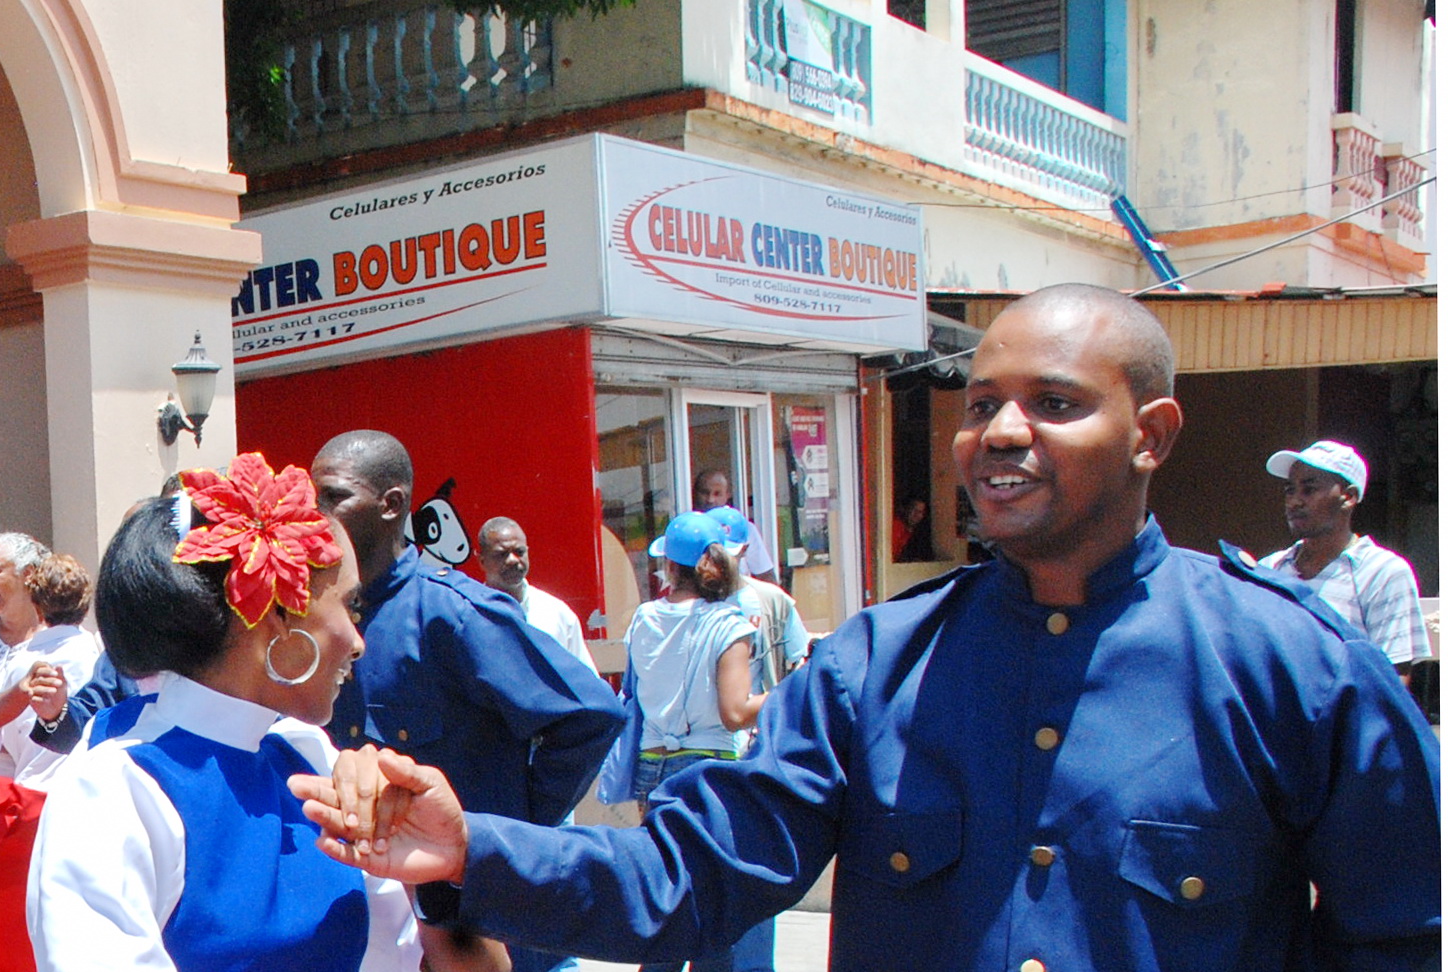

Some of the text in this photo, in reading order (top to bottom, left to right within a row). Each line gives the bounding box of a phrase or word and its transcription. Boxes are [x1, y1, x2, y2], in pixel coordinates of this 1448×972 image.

[329, 164, 547, 220] Celulares y Accesorios
[826, 195, 917, 225] Celulares y Accesorios
[232, 210, 547, 317] NTER BOUTIQUE
[648, 203, 917, 291] CELULAR CENTER BOUTIQUE
[715, 273, 872, 304] Import of Cellular and accessories
[754, 293, 841, 313] 809-528-7117
[232, 297, 426, 339] llular and accessories
[234, 322, 356, 352] -528-7117
